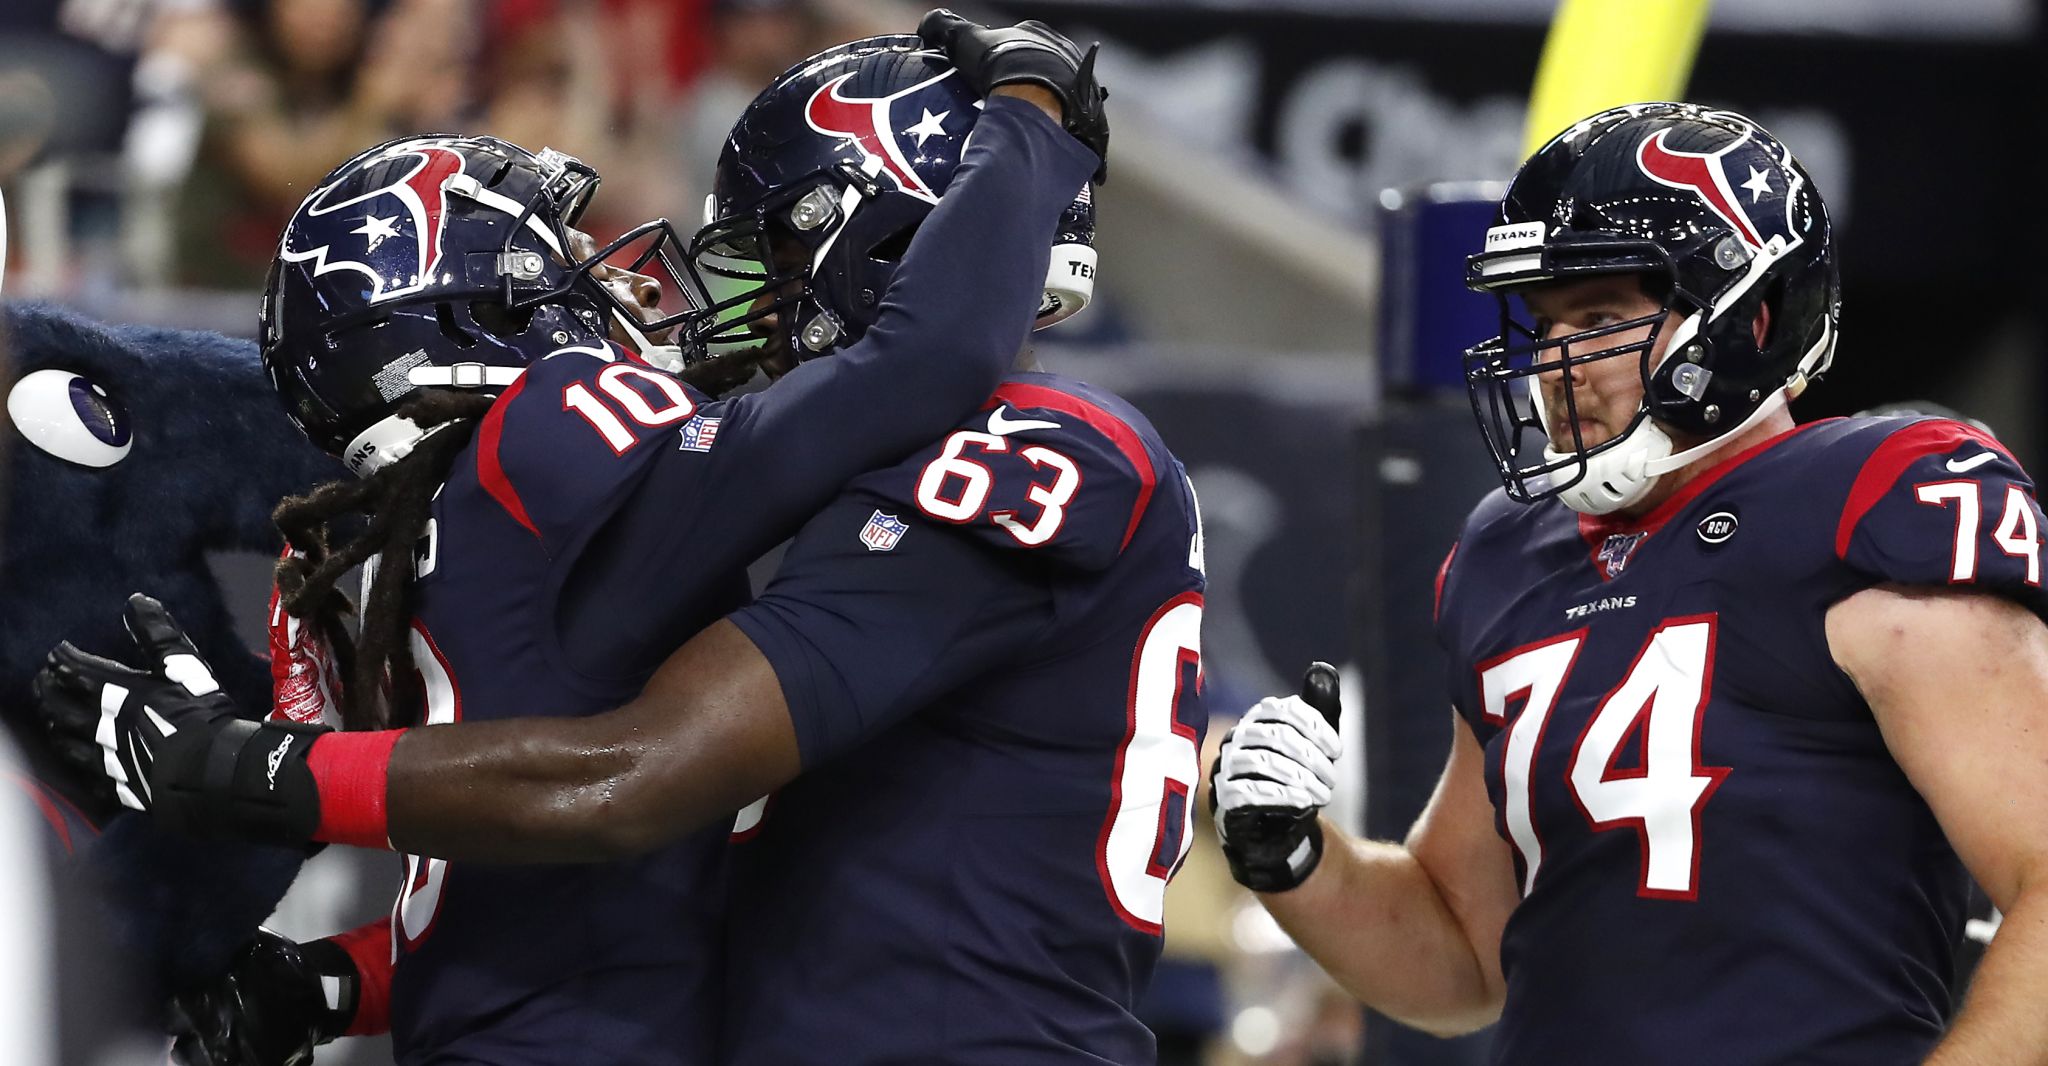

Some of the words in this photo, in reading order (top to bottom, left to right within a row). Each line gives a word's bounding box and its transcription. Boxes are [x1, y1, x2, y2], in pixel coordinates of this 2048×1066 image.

[1488, 230, 1538, 243] TEXANS
[561, 361, 697, 457] 10
[914, 428, 1083, 548] 63
[1912, 478, 2045, 588] 74
[1564, 596, 1637, 620] TEXANS
[1474, 612, 1733, 902] 74
